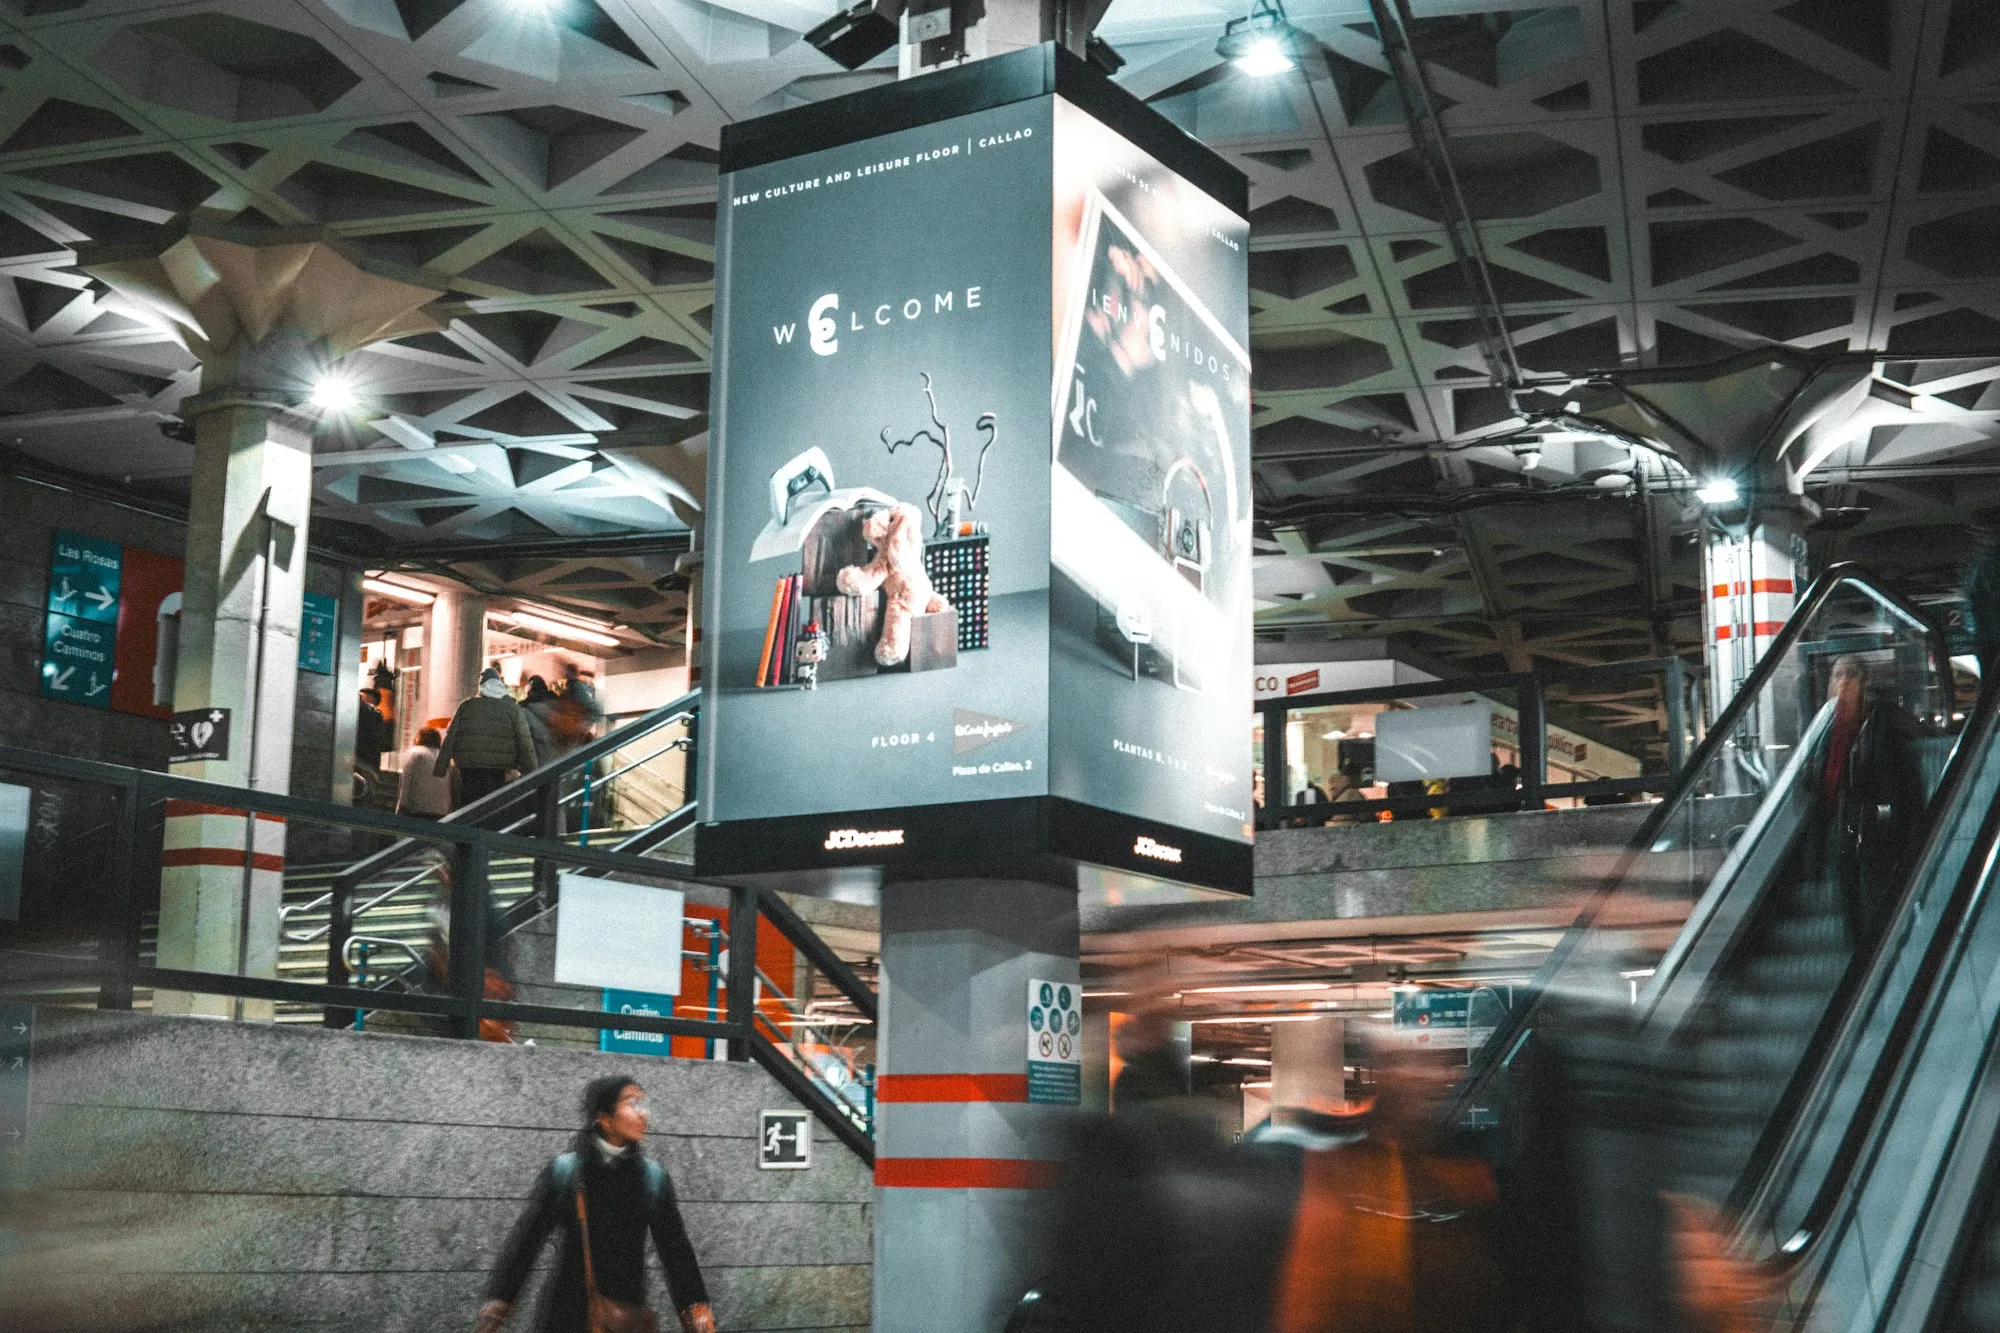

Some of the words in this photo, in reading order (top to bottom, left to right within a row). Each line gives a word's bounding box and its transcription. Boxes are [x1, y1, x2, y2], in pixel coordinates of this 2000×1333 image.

[733, 192, 760, 207] NEW
[765, 178, 820, 199] CULTURE
[826, 171, 851, 185] AND
[857, 157, 910, 177] LEISURE
[916, 145, 960, 163] FLOOR
[979, 127, 1033, 148] CALLAO
[1212, 228, 1239, 251] CALLAO
[1092, 287, 1231, 382] IENVENIDOS
[58, 543, 80, 560] Las
[82, 549, 120, 570] Rosas
[60, 623, 102, 643] Cuatro
[53, 640, 106, 662] Caminos
[871, 733, 920, 748] FLOOR
[926, 731, 936, 743] 4
[1113, 739, 1153, 760] PLANTAS
[952, 766, 977, 777] Plaza
[978, 763, 991, 774] de
[1025, 760, 1033, 770] 2
